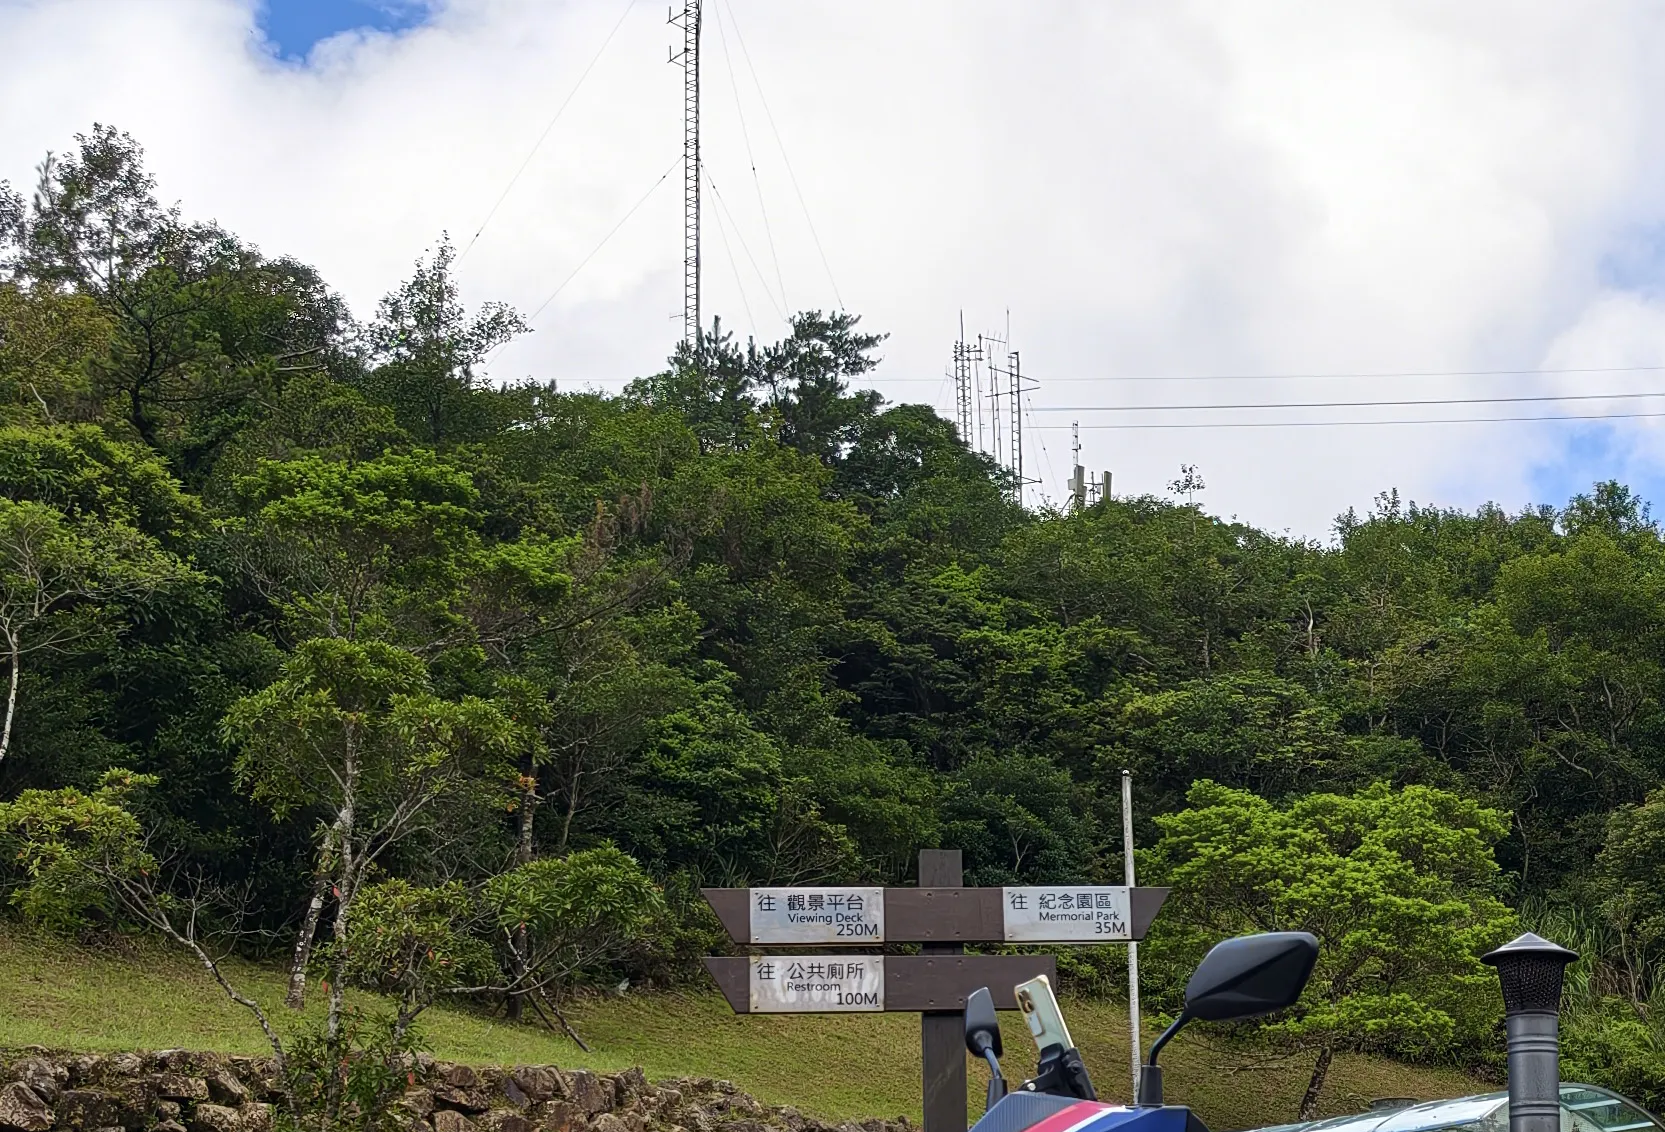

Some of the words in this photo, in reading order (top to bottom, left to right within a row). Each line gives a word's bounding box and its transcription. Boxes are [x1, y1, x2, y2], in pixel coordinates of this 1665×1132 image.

[758, 894, 776, 911] 往
[788, 894, 864, 911] 觀景平台
[1010, 894, 1028, 909] 往
[1039, 893, 1112, 909] 紀念園區
[788, 913, 833, 925] Viewing
[836, 913, 863, 923] Deck
[1040, 912, 1094, 921] Mermorial
[1097, 912, 1119, 920] Park
[836, 924, 878, 936] 250M
[1095, 922, 1126, 934] 35M
[757, 963, 776, 980] 往
[787, 963, 864, 980] 公共廁所
[787, 982, 841, 992] Restroom
[837, 993, 878, 1005] 100M
